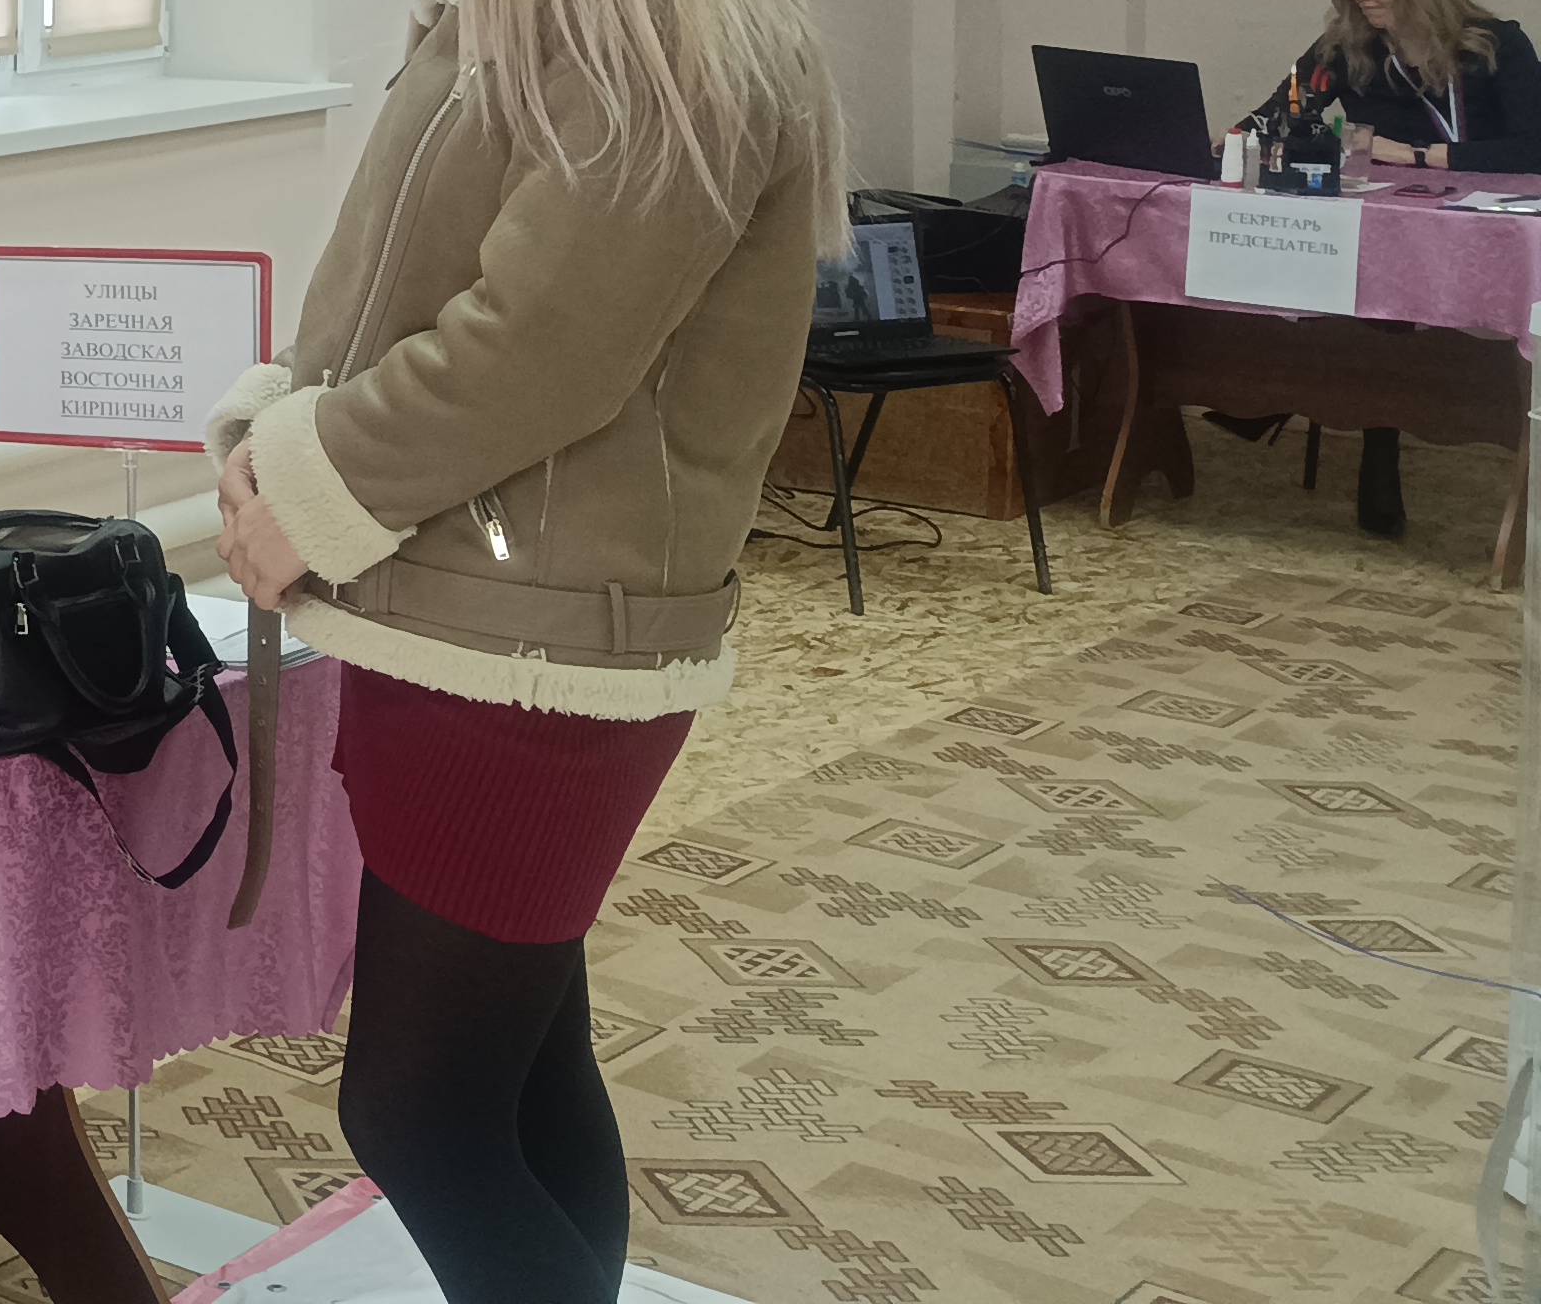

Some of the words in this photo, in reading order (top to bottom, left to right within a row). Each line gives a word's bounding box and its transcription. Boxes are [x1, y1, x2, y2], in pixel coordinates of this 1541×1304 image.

[1227, 211, 1322, 233] СЕКРЕТАРЬ
[1208, 230, 1339, 256] ПРЕДСЕДАТЕЛЬ
[84, 284, 157, 302] УЛИЦЫ
[69, 312, 173, 331] ЗАРЕЧНАЯ
[60, 341, 182, 361] ЗАВОДСКАЯ
[60, 370, 184, 390] ВОСТОЧНАЯ
[60, 399, 184, 420] КИРПИЧНАЯ
